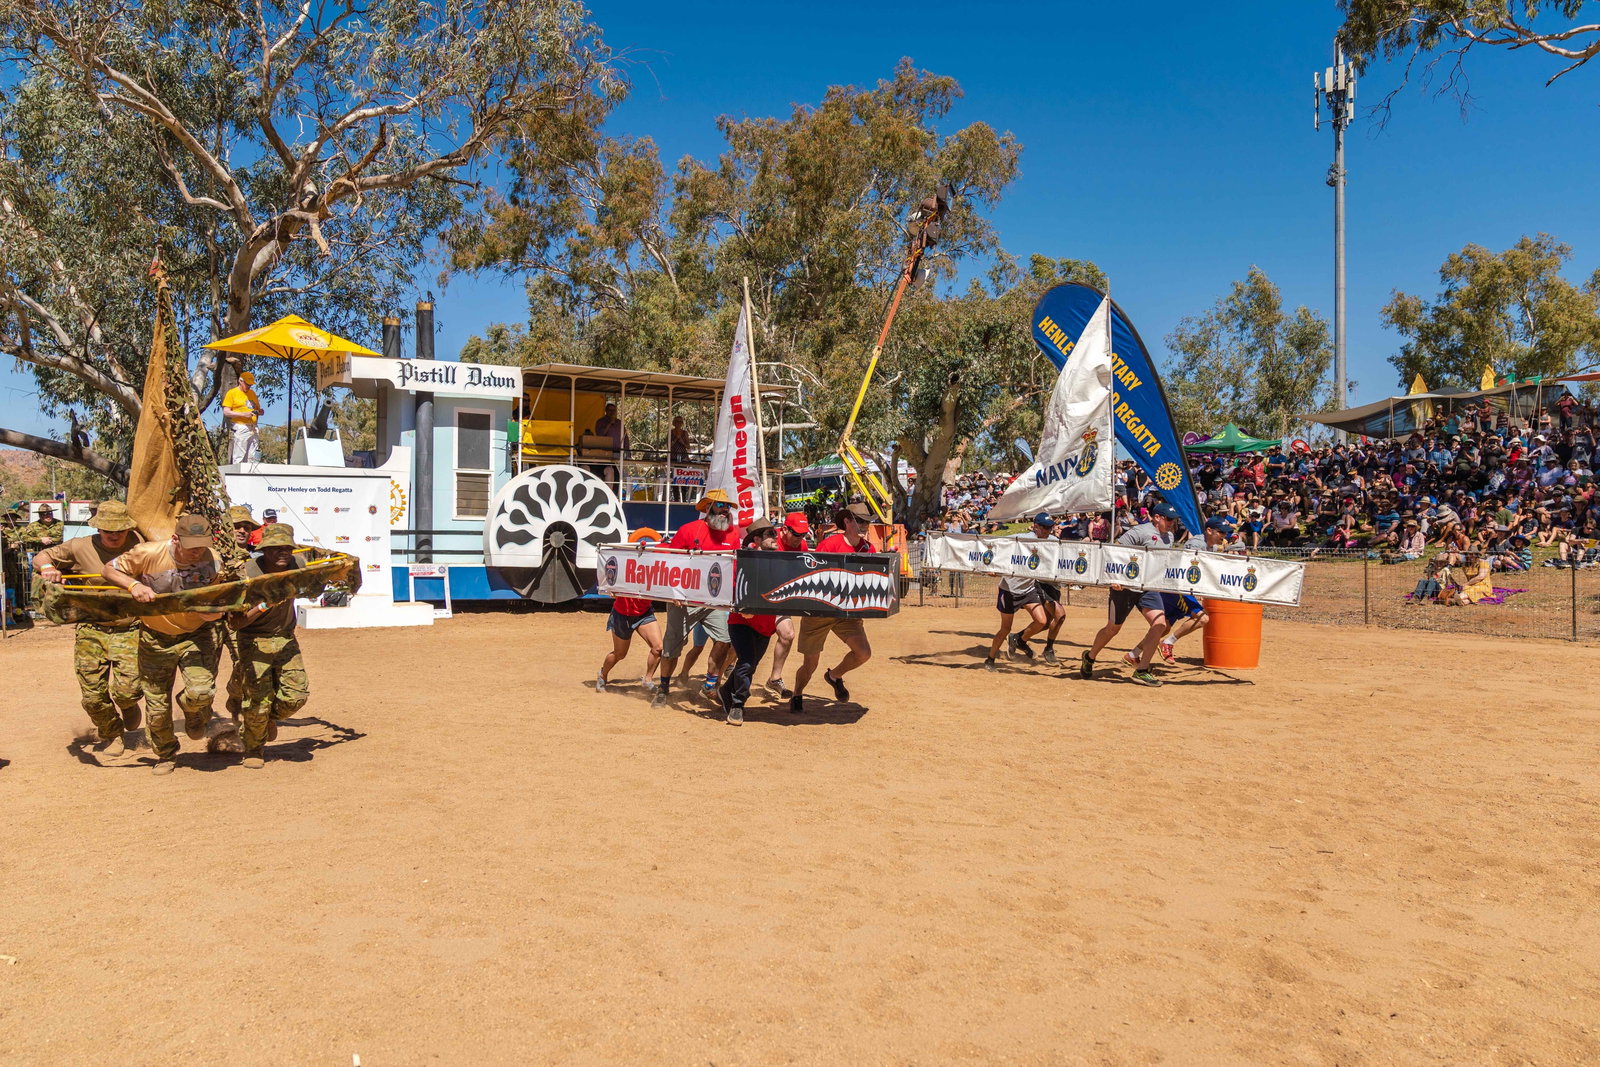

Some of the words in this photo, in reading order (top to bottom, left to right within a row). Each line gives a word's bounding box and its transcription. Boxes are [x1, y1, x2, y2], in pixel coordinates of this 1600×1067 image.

[1038, 315, 1076, 357] HENLE
[396, 361, 457, 387] Pistill
[465, 366, 516, 390] Dawn
[1114, 401, 1162, 457] REGATTA
[730, 395, 755, 528] Raytheon
[1035, 455, 1079, 488] NAVY
[968, 551, 983, 562] NAVY
[1011, 554, 1028, 566] NAVY
[1057, 559, 1075, 570] NAVY
[625, 558, 702, 591] Raytheon
[1105, 562, 1126, 574] NAVY
[1164, 567, 1187, 580] NAVY
[1219, 573, 1244, 587] NAVY
